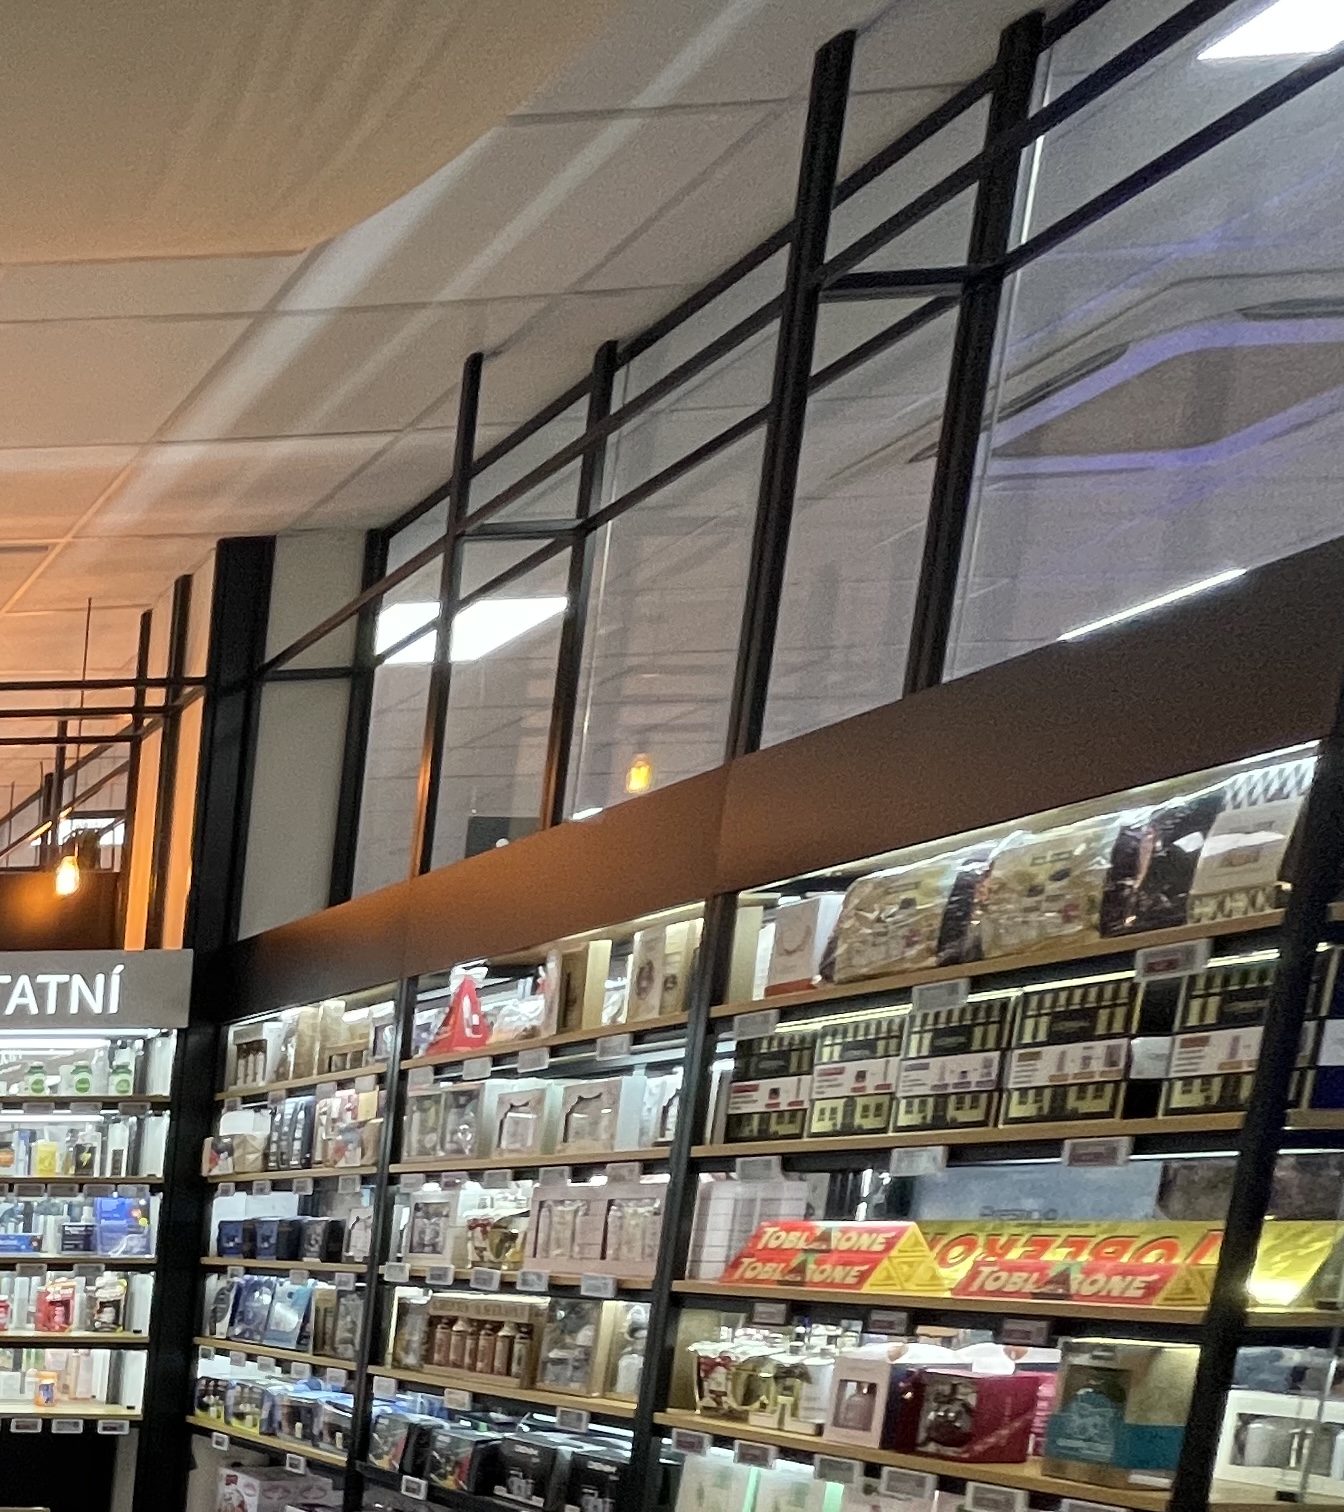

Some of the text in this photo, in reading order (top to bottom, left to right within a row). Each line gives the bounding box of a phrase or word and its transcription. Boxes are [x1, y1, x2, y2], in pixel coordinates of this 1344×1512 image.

[754, 1226, 897, 1254] TOBLRONE
[732, 1257, 871, 1285] TOBLRONE
[968, 1266, 1159, 1298] TOBLRONE
